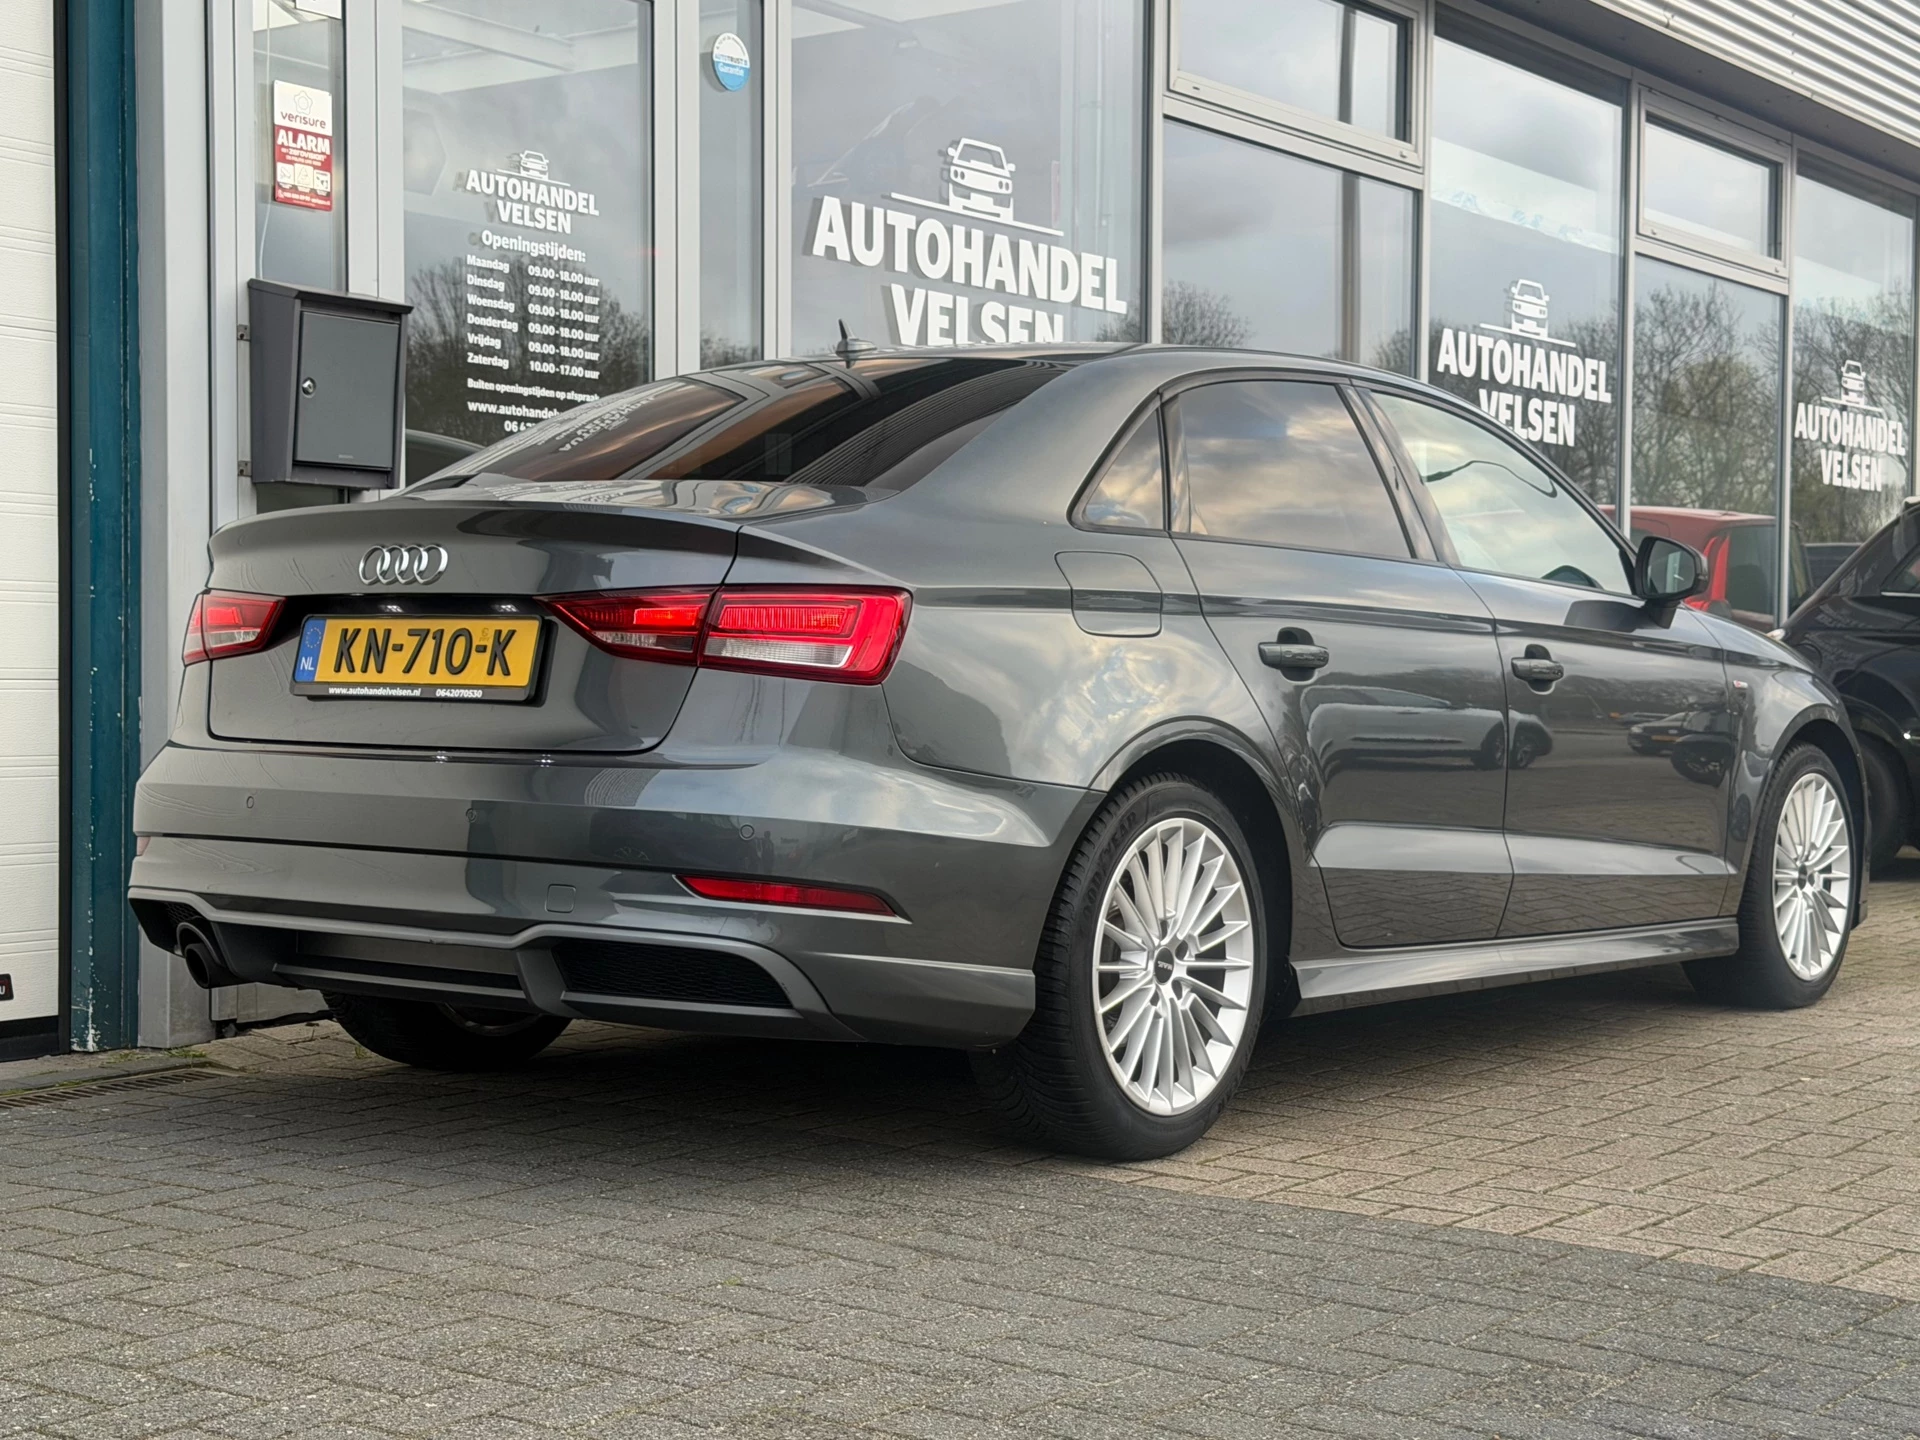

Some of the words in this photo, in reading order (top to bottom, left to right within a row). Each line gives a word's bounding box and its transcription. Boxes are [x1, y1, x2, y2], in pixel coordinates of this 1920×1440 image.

[281, 111, 326, 129] verisure
[277, 129, 331, 155] ALARM
[466, 169, 600, 216] AUTOHANDEL
[497, 200, 571, 234] VELSEN
[481, 229, 586, 262] Openingstijden:
[812, 195, 1127, 314] AUTOHANDEL
[467, 254, 510, 273] Maandag
[584, 276, 600, 286] uur
[467, 274, 505, 292] Dinsdag
[584, 295, 600, 305] uur
[467, 293, 515, 313] Woensdag
[584, 314, 600, 324] uur
[890, 283, 1063, 346] VELSEN
[467, 313, 518, 332] Donderdag
[584, 332, 600, 342] uur
[467, 332, 502, 350] Vrijdag
[584, 351, 600, 361] uur
[467, 352, 509, 369] Zaterdag
[584, 370, 600, 379] uur
[1437, 328, 1612, 403] AUTOHANDEL
[467, 378, 495, 391] Buiten
[495, 383, 555, 398] openingstijden
[556, 390, 566, 401] op
[503, 419, 519, 433] 06
[1479, 388, 1575, 447] VELSEN
[1794, 402, 1906, 456] AUTOHANDEL
[1820, 449, 1882, 492] VELSEN
[300, 656, 315, 671] NL
[333, 627, 517, 676] KN-710-K
[328, 686, 422, 697] www.autohandelvelsen.nl
[435, 688, 483, 698] 0642070530
